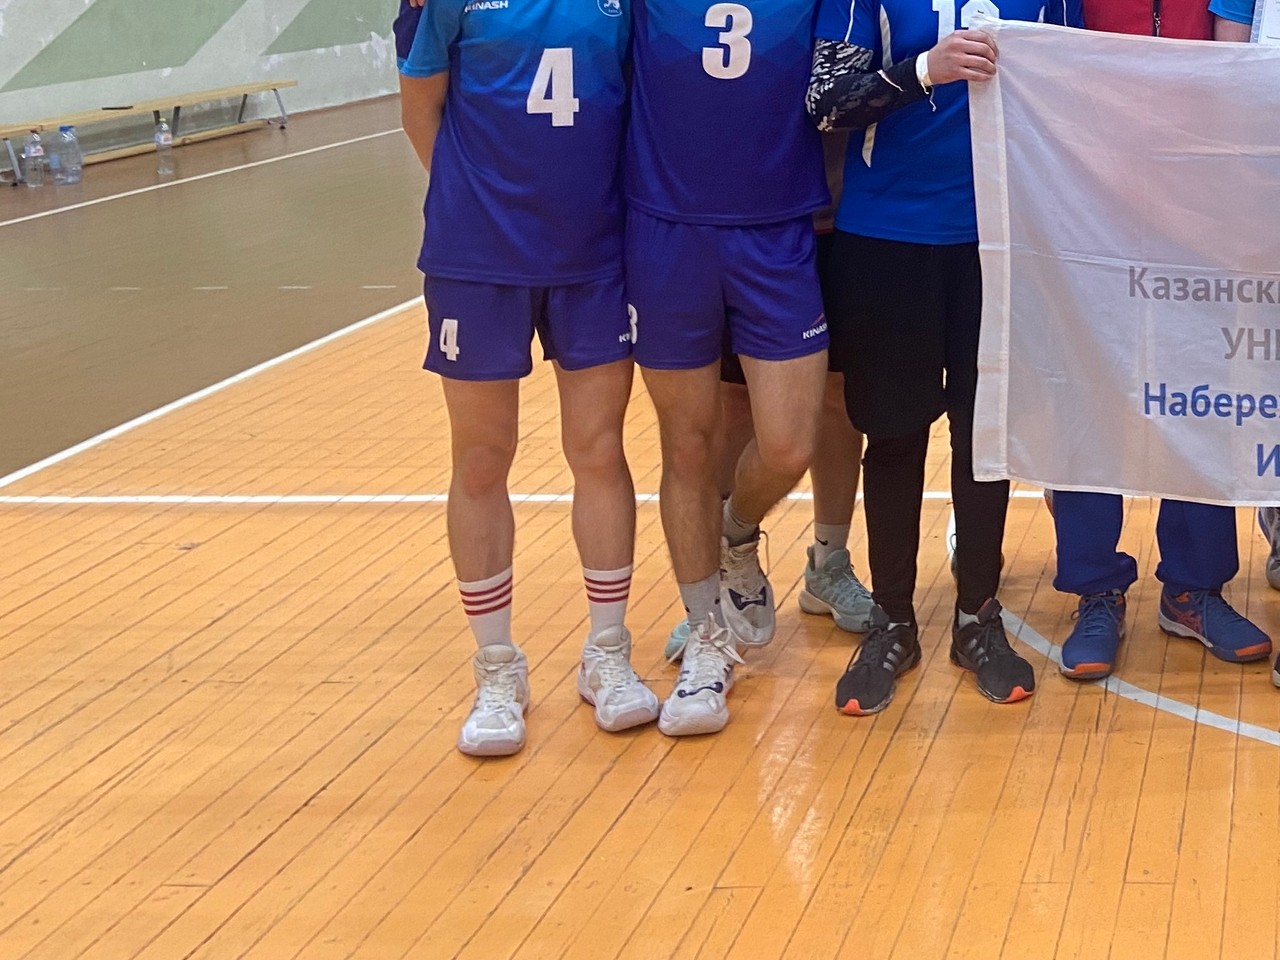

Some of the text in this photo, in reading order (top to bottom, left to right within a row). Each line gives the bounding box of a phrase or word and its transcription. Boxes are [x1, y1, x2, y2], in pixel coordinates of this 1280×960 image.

[702, 3, 754, 79] 3
[526, 47, 580, 127] 4
[439, 318, 460, 361] 4
